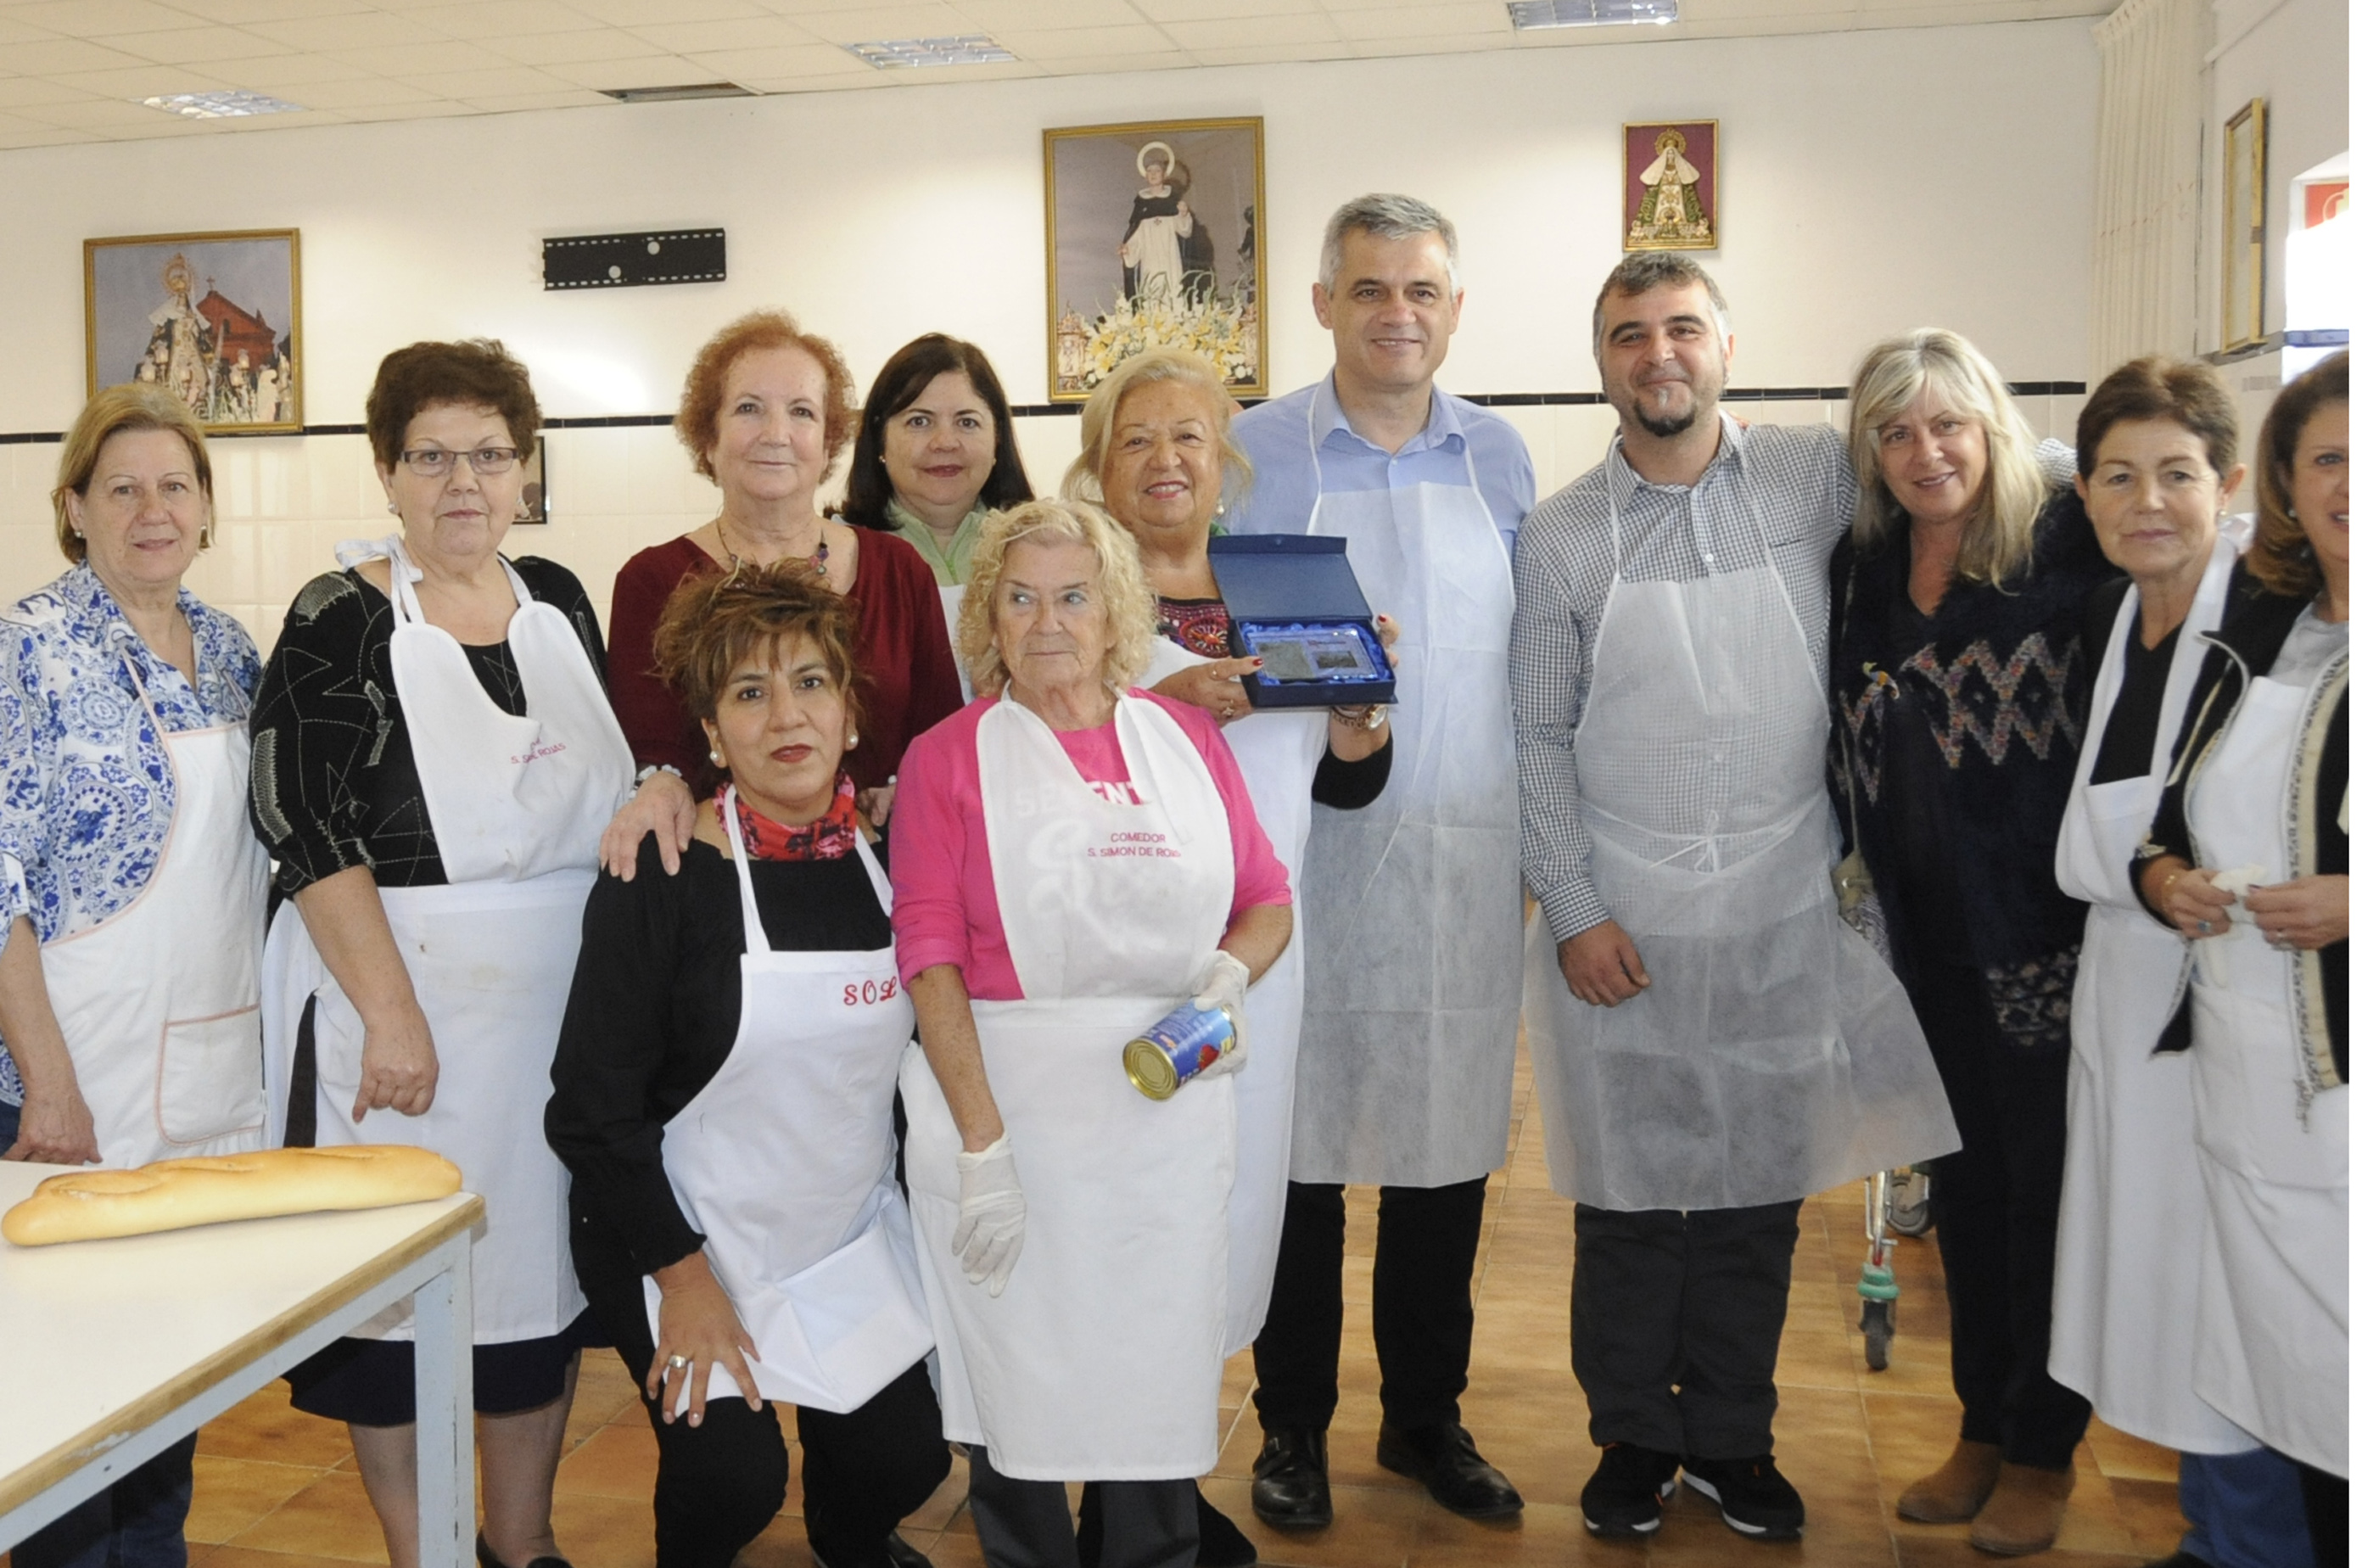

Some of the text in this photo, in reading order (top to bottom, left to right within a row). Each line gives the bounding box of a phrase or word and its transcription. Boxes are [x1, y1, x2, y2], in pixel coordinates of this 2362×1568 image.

[1110, 832, 1166, 843] COMEDOR
[1100, 847, 1136, 857] SIMON
[1139, 847, 1153, 856] DE
[843, 976, 897, 1005] SOL
